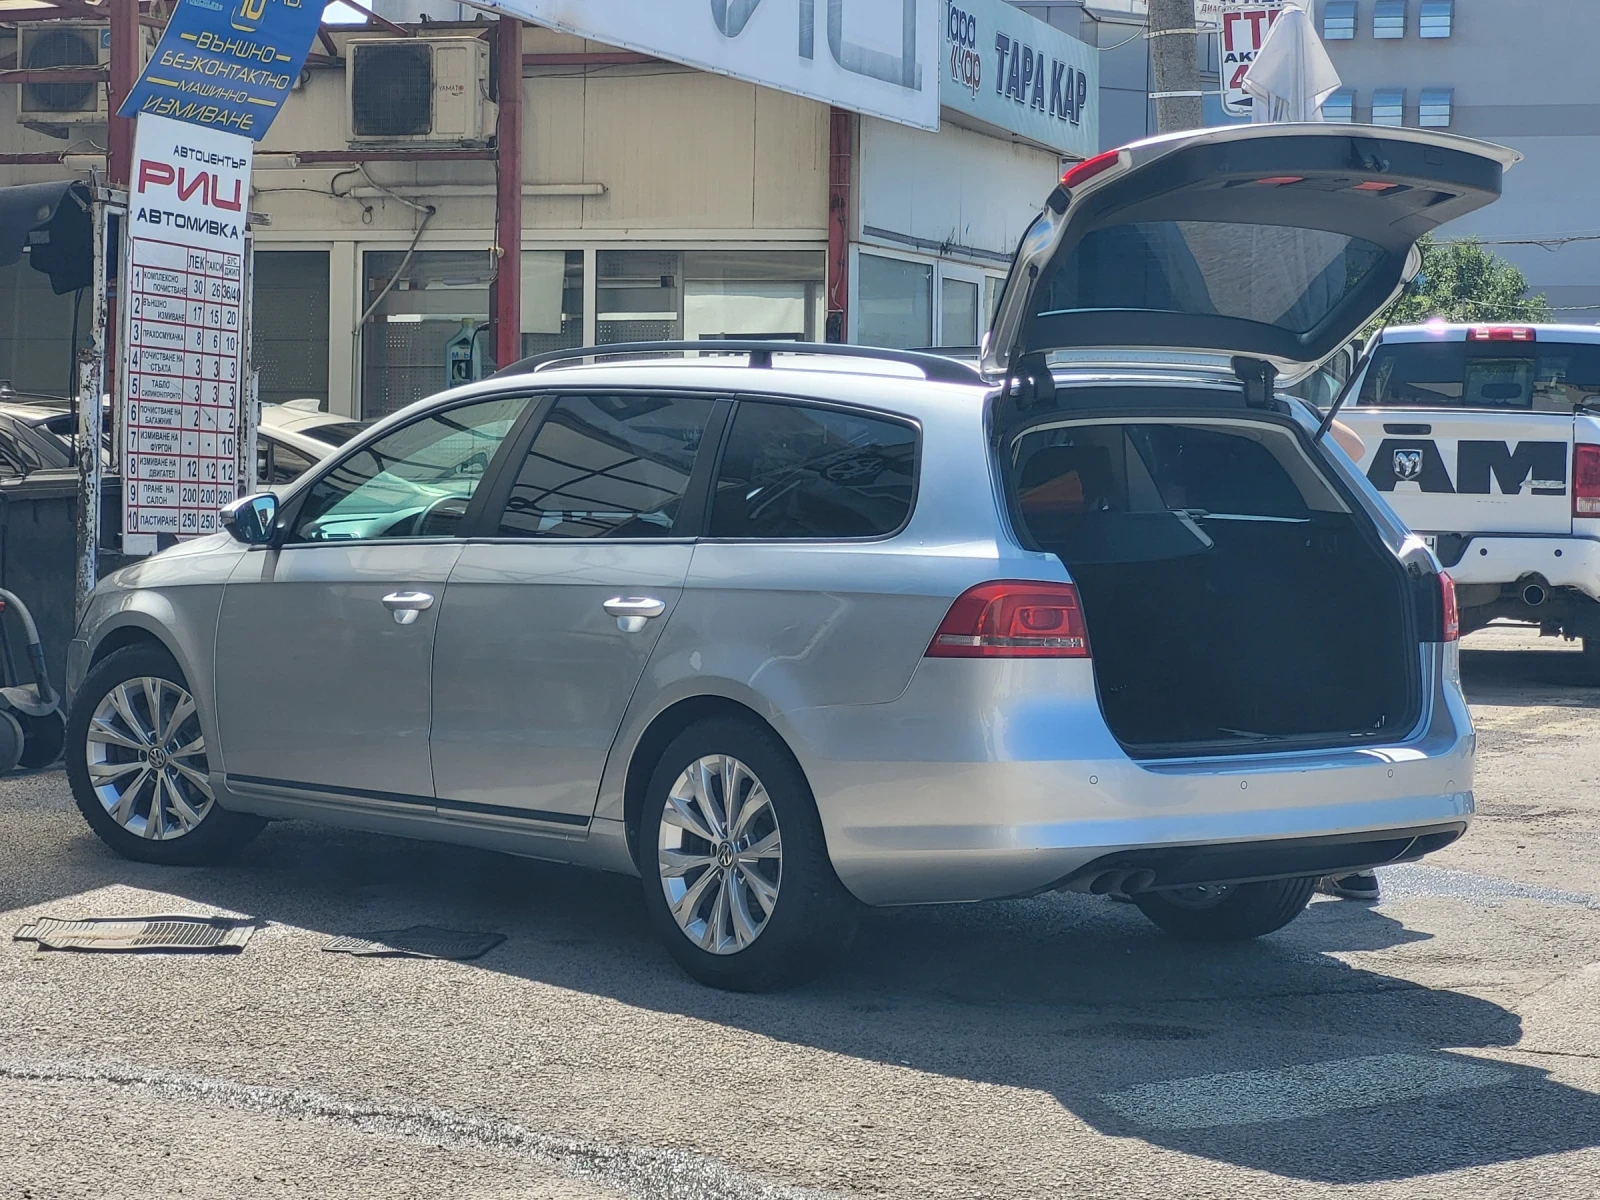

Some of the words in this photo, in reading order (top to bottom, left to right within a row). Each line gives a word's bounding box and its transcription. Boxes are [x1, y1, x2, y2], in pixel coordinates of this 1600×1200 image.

[1223, 10, 1281, 51] ГТ
[196, 32, 276, 63] ВЪНШНО
[160, 51, 290, 90] БЕЗКОНТАКТНО
[996, 30, 1045, 112] ТАРА
[1050, 58, 1087, 126] КАР
[178, 80, 248, 103] МАШИННО
[143, 95, 254, 130] ИЗМИВАНЕ
[138, 159, 241, 212] РИЦ
[136, 208, 239, 240] АВТОМИВКА
[188, 255, 206, 270] ЛЕК
[206, 260, 224, 272] ТАКСИ
[224, 267, 240, 276] ДЖИП
[135, 271, 140, 288] 1
[144, 272, 178, 284] КОМПЛЕКСНО
[153, 284, 187, 295] ПОЧИСТВАНЕ
[194, 280, 203, 294] 30
[212, 283, 220, 298] 26
[222, 284, 240, 302] 36/40
[134, 298, 140, 314] 2
[143, 298, 168, 308] ВЪНШНО
[158, 312, 185, 322] ИЗМИВАНЕ
[193, 306, 202, 320] 17
[210, 309, 219, 324] 15
[226, 311, 236, 325] 20
[134, 324, 139, 340] 3
[142, 330, 184, 341] ПРАХОСМУКАЧКА
[196, 332, 202, 346] 8
[214, 335, 218, 348] 6
[226, 337, 235, 350] 10
[132, 351, 138, 368] 4
[142, 351, 176, 362] ПОЧИСТВАНЕ
[176, 354, 183, 362] НА
[150, 364, 172, 373] СТЪКЛА
[196, 359, 200, 376] 3
[214, 361, 219, 378] 3
[230, 362, 235, 378] 3
[132, 378, 138, 394] 5
[152, 380, 170, 390] ТАБЛО
[194, 385, 200, 402] 3
[212, 386, 218, 402] 3
[229, 386, 234, 402] 3
[131, 404, 136, 421] 6
[140, 406, 174, 416] ПОЧИСТВАНЕ
[174, 408, 181, 416] НА
[145, 416, 172, 426] БАГАЖНИК
[194, 410, 199, 426] 2
[228, 412, 234, 428] 2
[131, 432, 136, 448] 7
[140, 431, 170, 441] ИЗМИВАНЕ
[150, 443, 172, 452] ФУРГОН
[222, 438, 232, 455] 10
[130, 458, 136, 474] 8
[140, 456, 168, 466] ИЗМИВАНЕ
[170, 458, 176, 467] НА
[187, 460, 196, 478] 12
[206, 463, 216, 479] 12
[222, 464, 232, 480] 12
[1366, 439, 1568, 495] AM
[148, 470, 176, 478] ДВИГАТЕЛ
[130, 485, 136, 502] 9
[143, 484, 162, 493] ПРАНЕ
[166, 485, 174, 494] НА
[146, 496, 168, 504] САЛОН
[182, 488, 196, 502] 200
[200, 489, 214, 504] 200
[218, 490, 232, 504] 280
[128, 511, 137, 530] 10
[140, 516, 178, 526] ПАСТИРАНЕ
[182, 514, 196, 528] 250
[200, 515, 214, 528] 250
